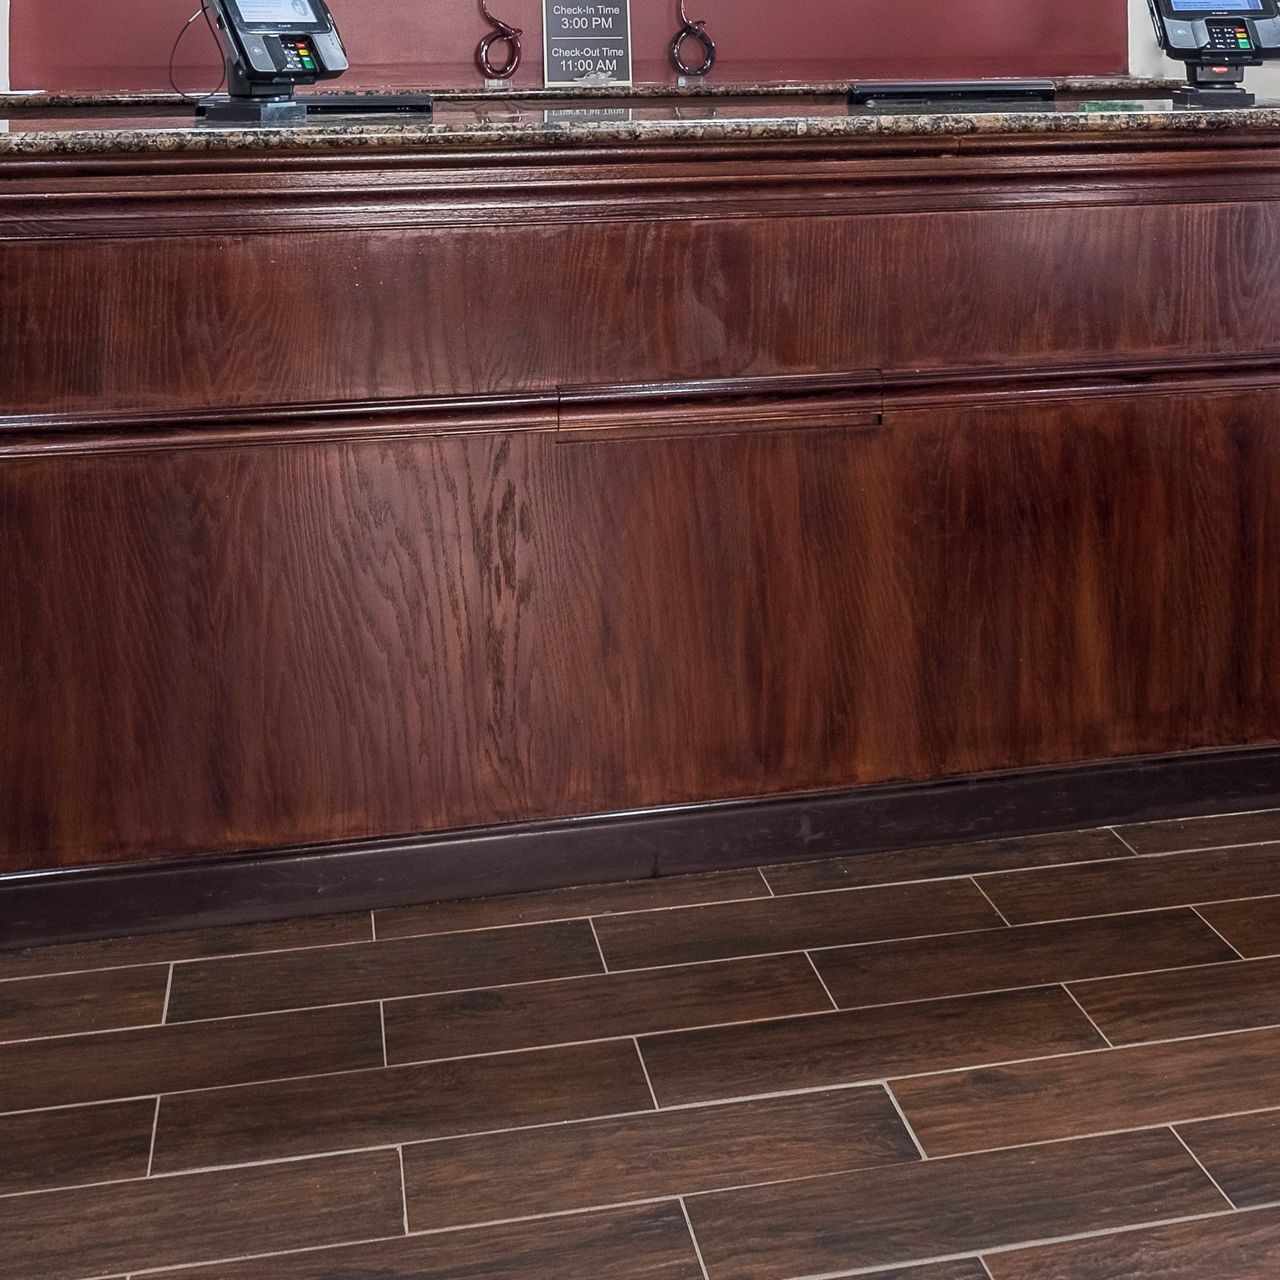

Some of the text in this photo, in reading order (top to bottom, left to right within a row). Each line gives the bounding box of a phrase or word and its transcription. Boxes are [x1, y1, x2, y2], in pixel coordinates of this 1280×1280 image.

[553, 5, 620, 15] Check-In Time
[561, 17, 613, 29] 3:00 PM
[551, 47, 624, 57] Check-Out Time
[560, 59, 617, 72] 11:00 AM
